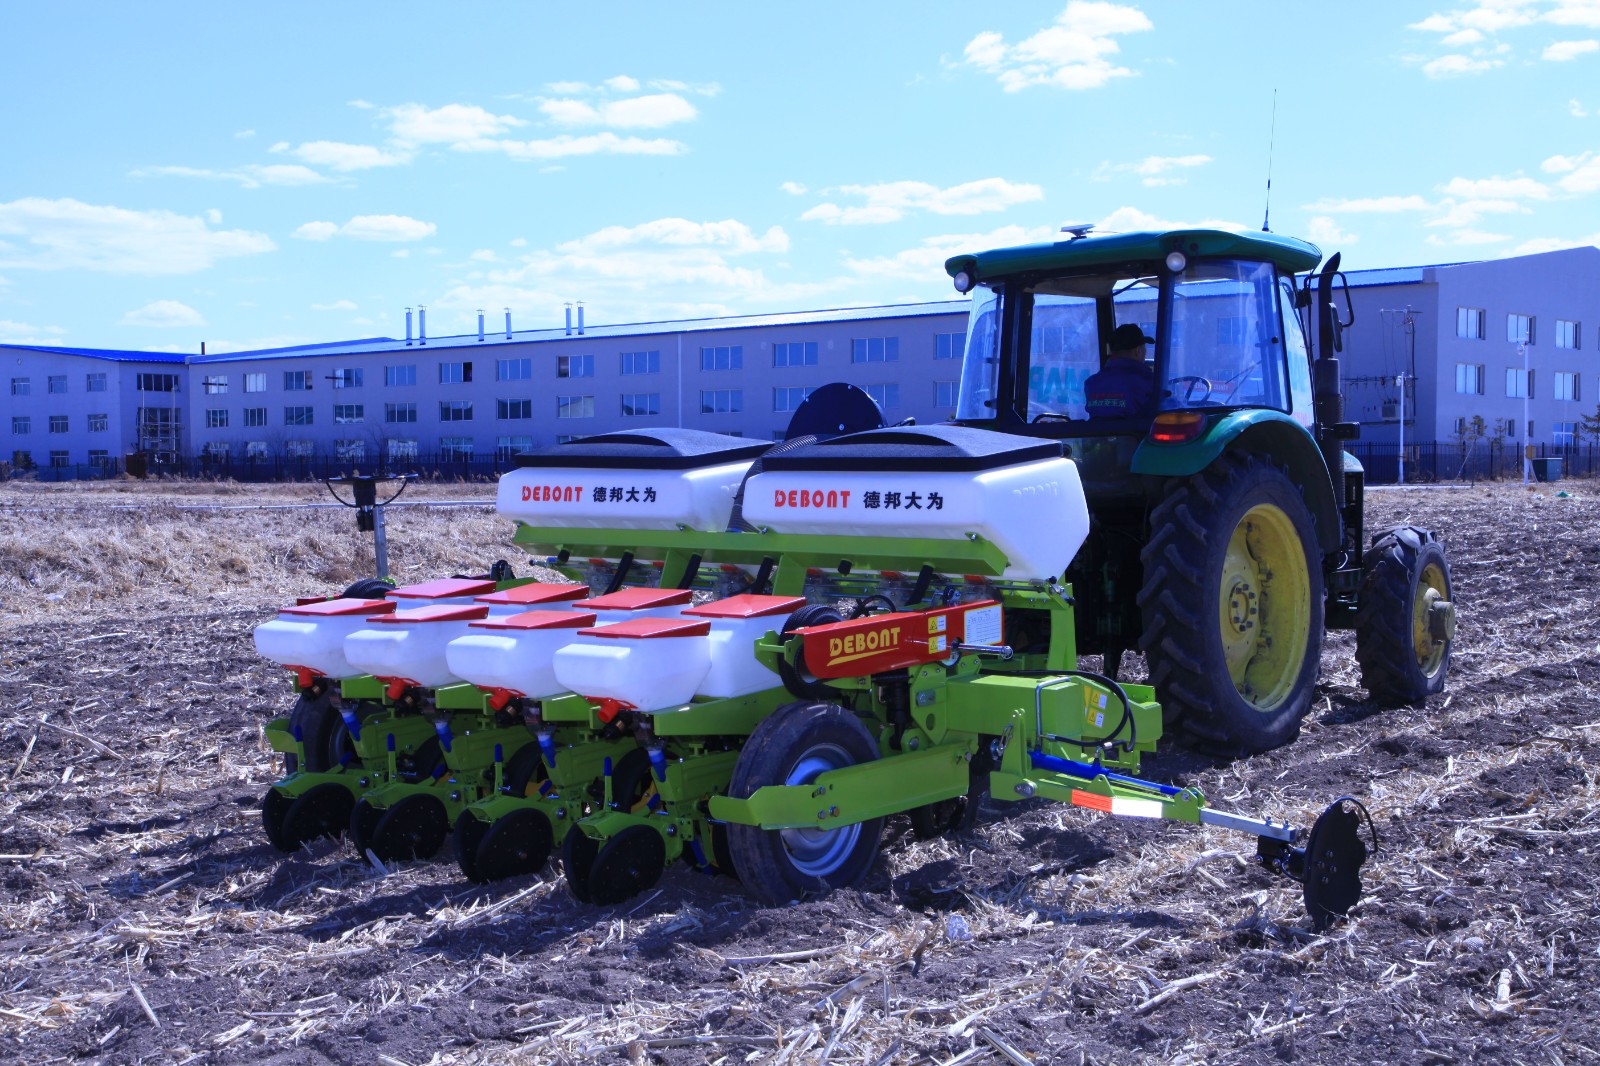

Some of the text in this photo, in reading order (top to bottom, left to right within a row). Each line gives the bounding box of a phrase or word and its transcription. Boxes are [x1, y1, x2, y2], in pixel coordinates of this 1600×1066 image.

[522, 485, 657, 503] DEBONT 德邦大为
[774, 490, 944, 510] DEBONT 德邦大为
[829, 626, 901, 657] DEBONT
